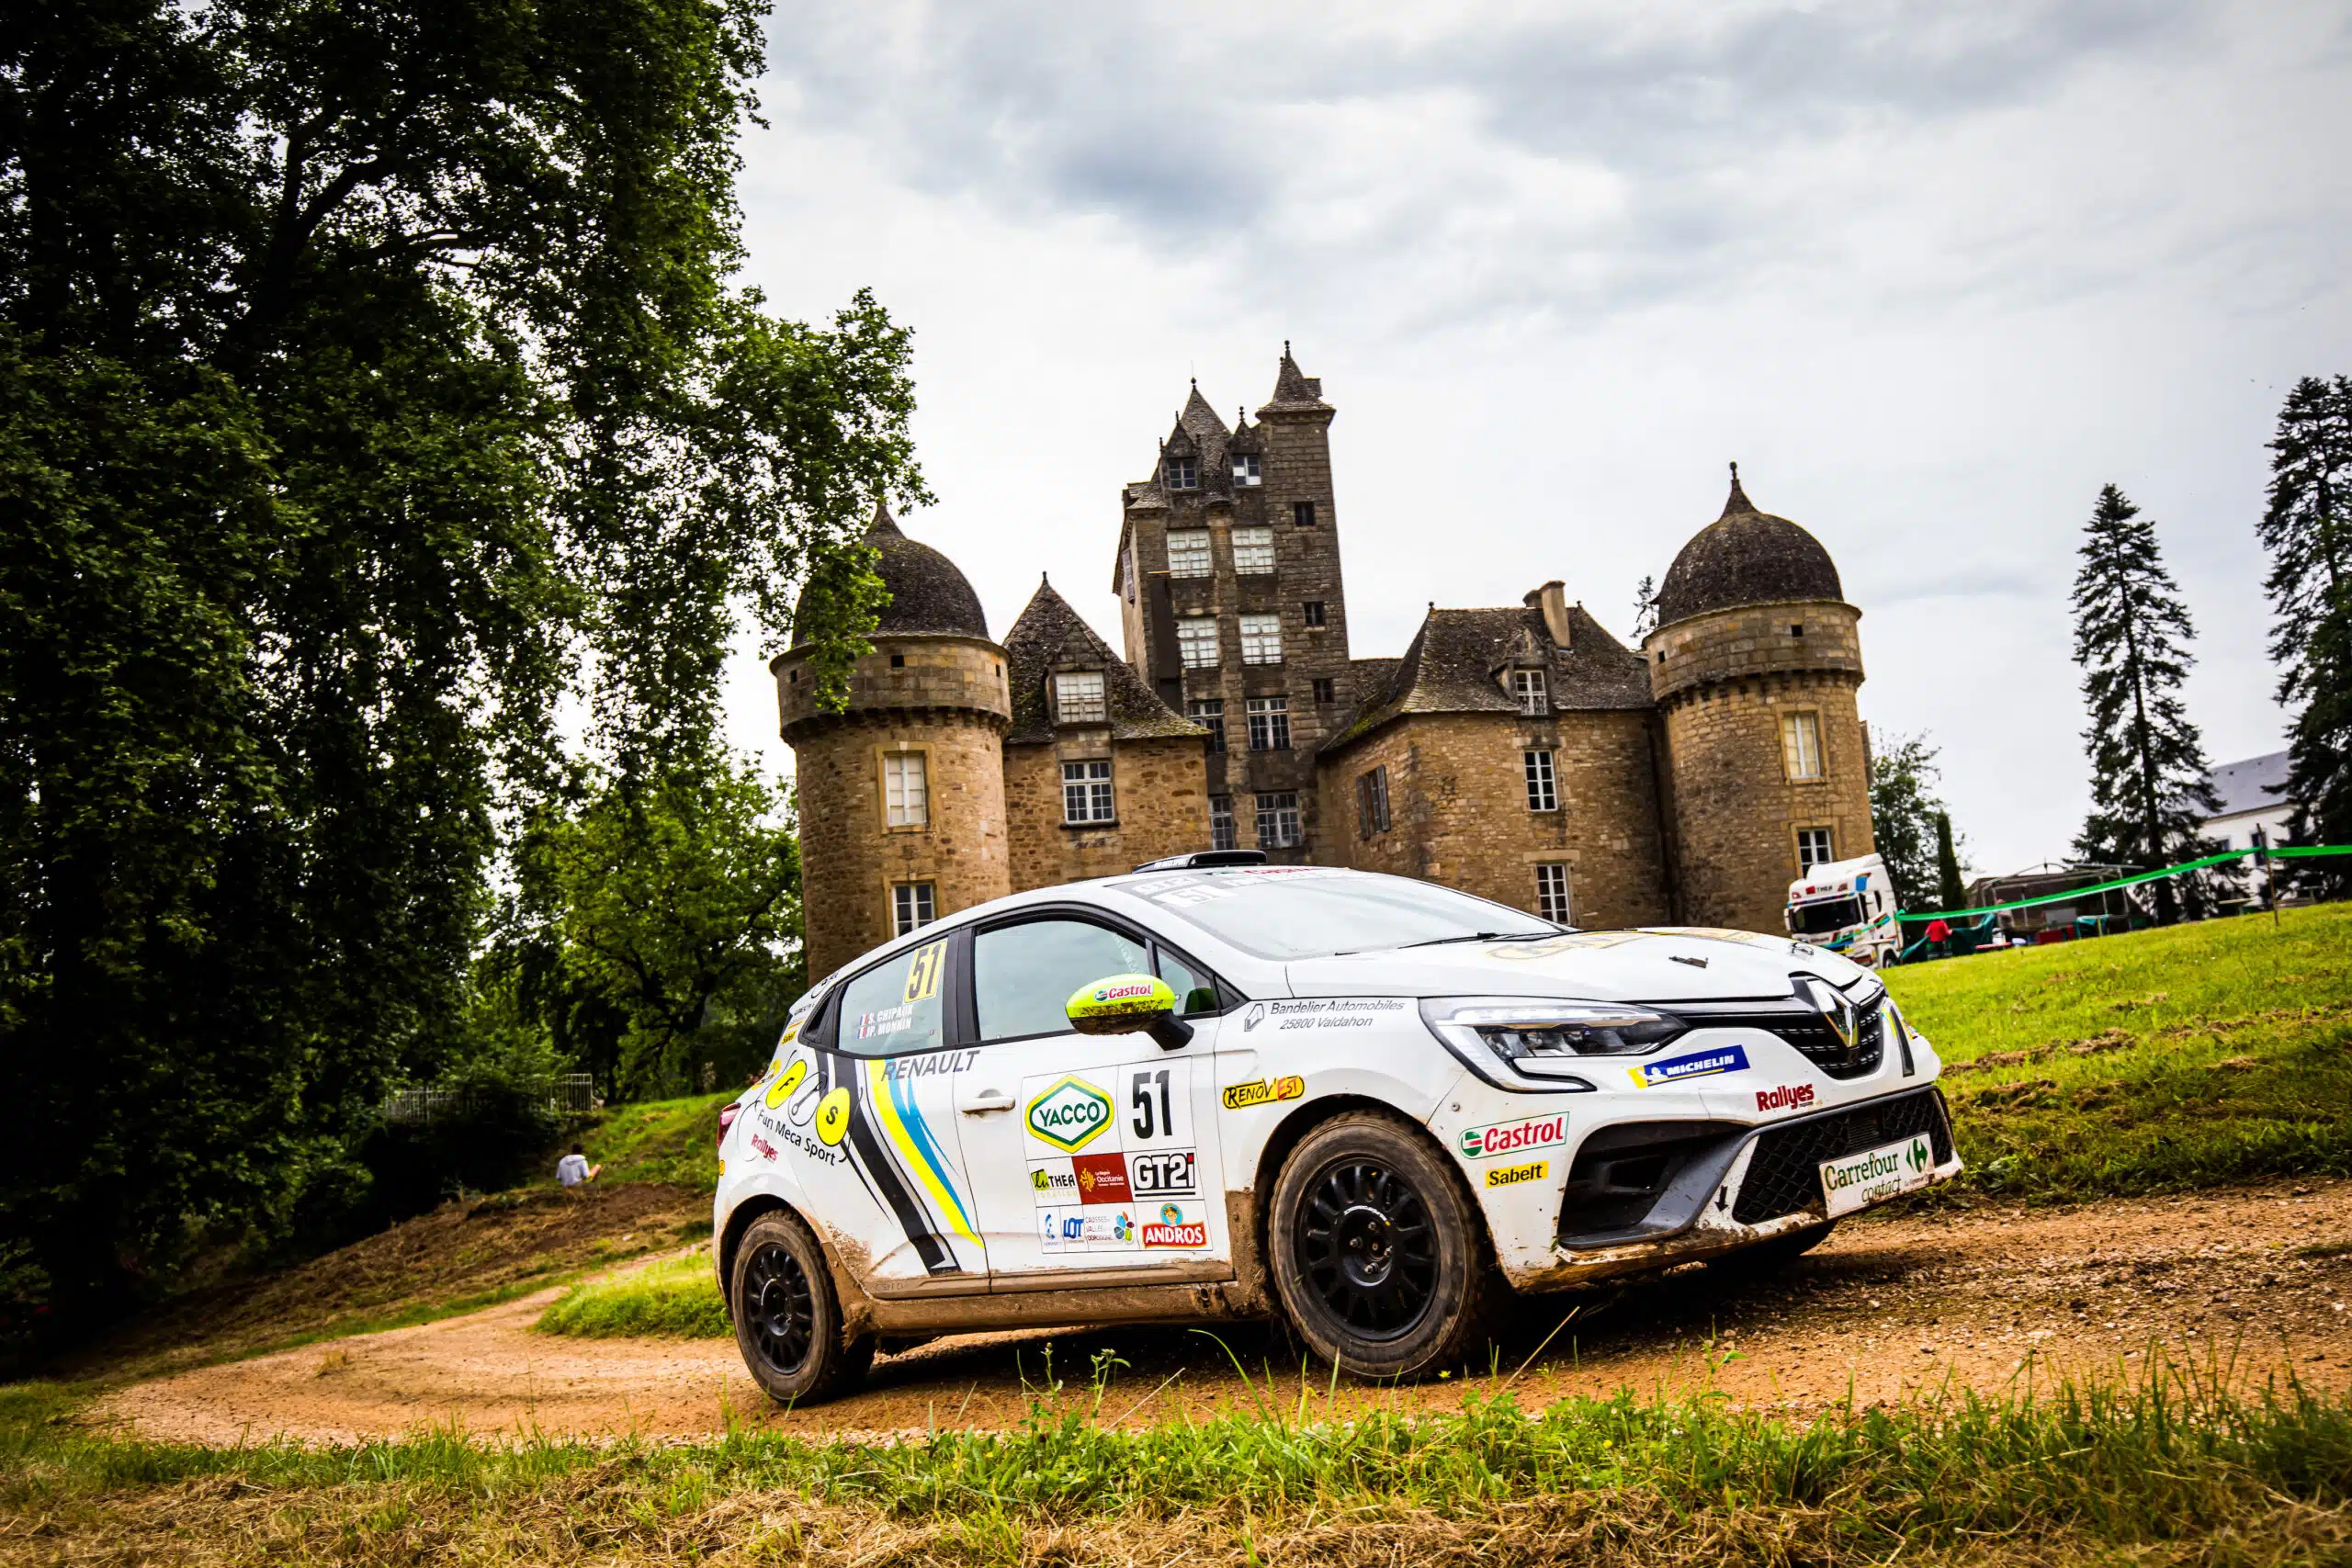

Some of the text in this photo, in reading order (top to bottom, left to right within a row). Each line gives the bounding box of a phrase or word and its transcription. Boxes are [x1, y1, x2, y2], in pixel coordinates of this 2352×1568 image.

[908, 943, 943, 999] 51
[1108, 984, 1152, 999] Castrol
[1270, 998, 1406, 1015] Bandelier Automobiles
[1279, 1015, 1374, 1031] 25800 Valdahon
[880, 1049, 981, 1082] RENAULT
[1666, 1054, 1735, 1076] MICHELIN
[1132, 1068, 1173, 1140] 51
[1755, 1082, 1815, 1112] Rallyes
[825, 1105, 840, 1126] S
[1038, 1100, 1101, 1128] YACCO
[751, 1133, 779, 1162] Rallyes
[757, 1109, 836, 1167] Fun Meca Sport
[1484, 1116, 1565, 1153] Castrol
[1096, 1174, 1125, 1184] Occitanie
[1132, 1152, 1195, 1191] GT2i
[1488, 1164, 1544, 1187] Sabelt
[1824, 1152, 1899, 1191] Carrefour
[1861, 1174, 1902, 1203] contact
[1145, 1225, 1204, 1245] ANDROS
